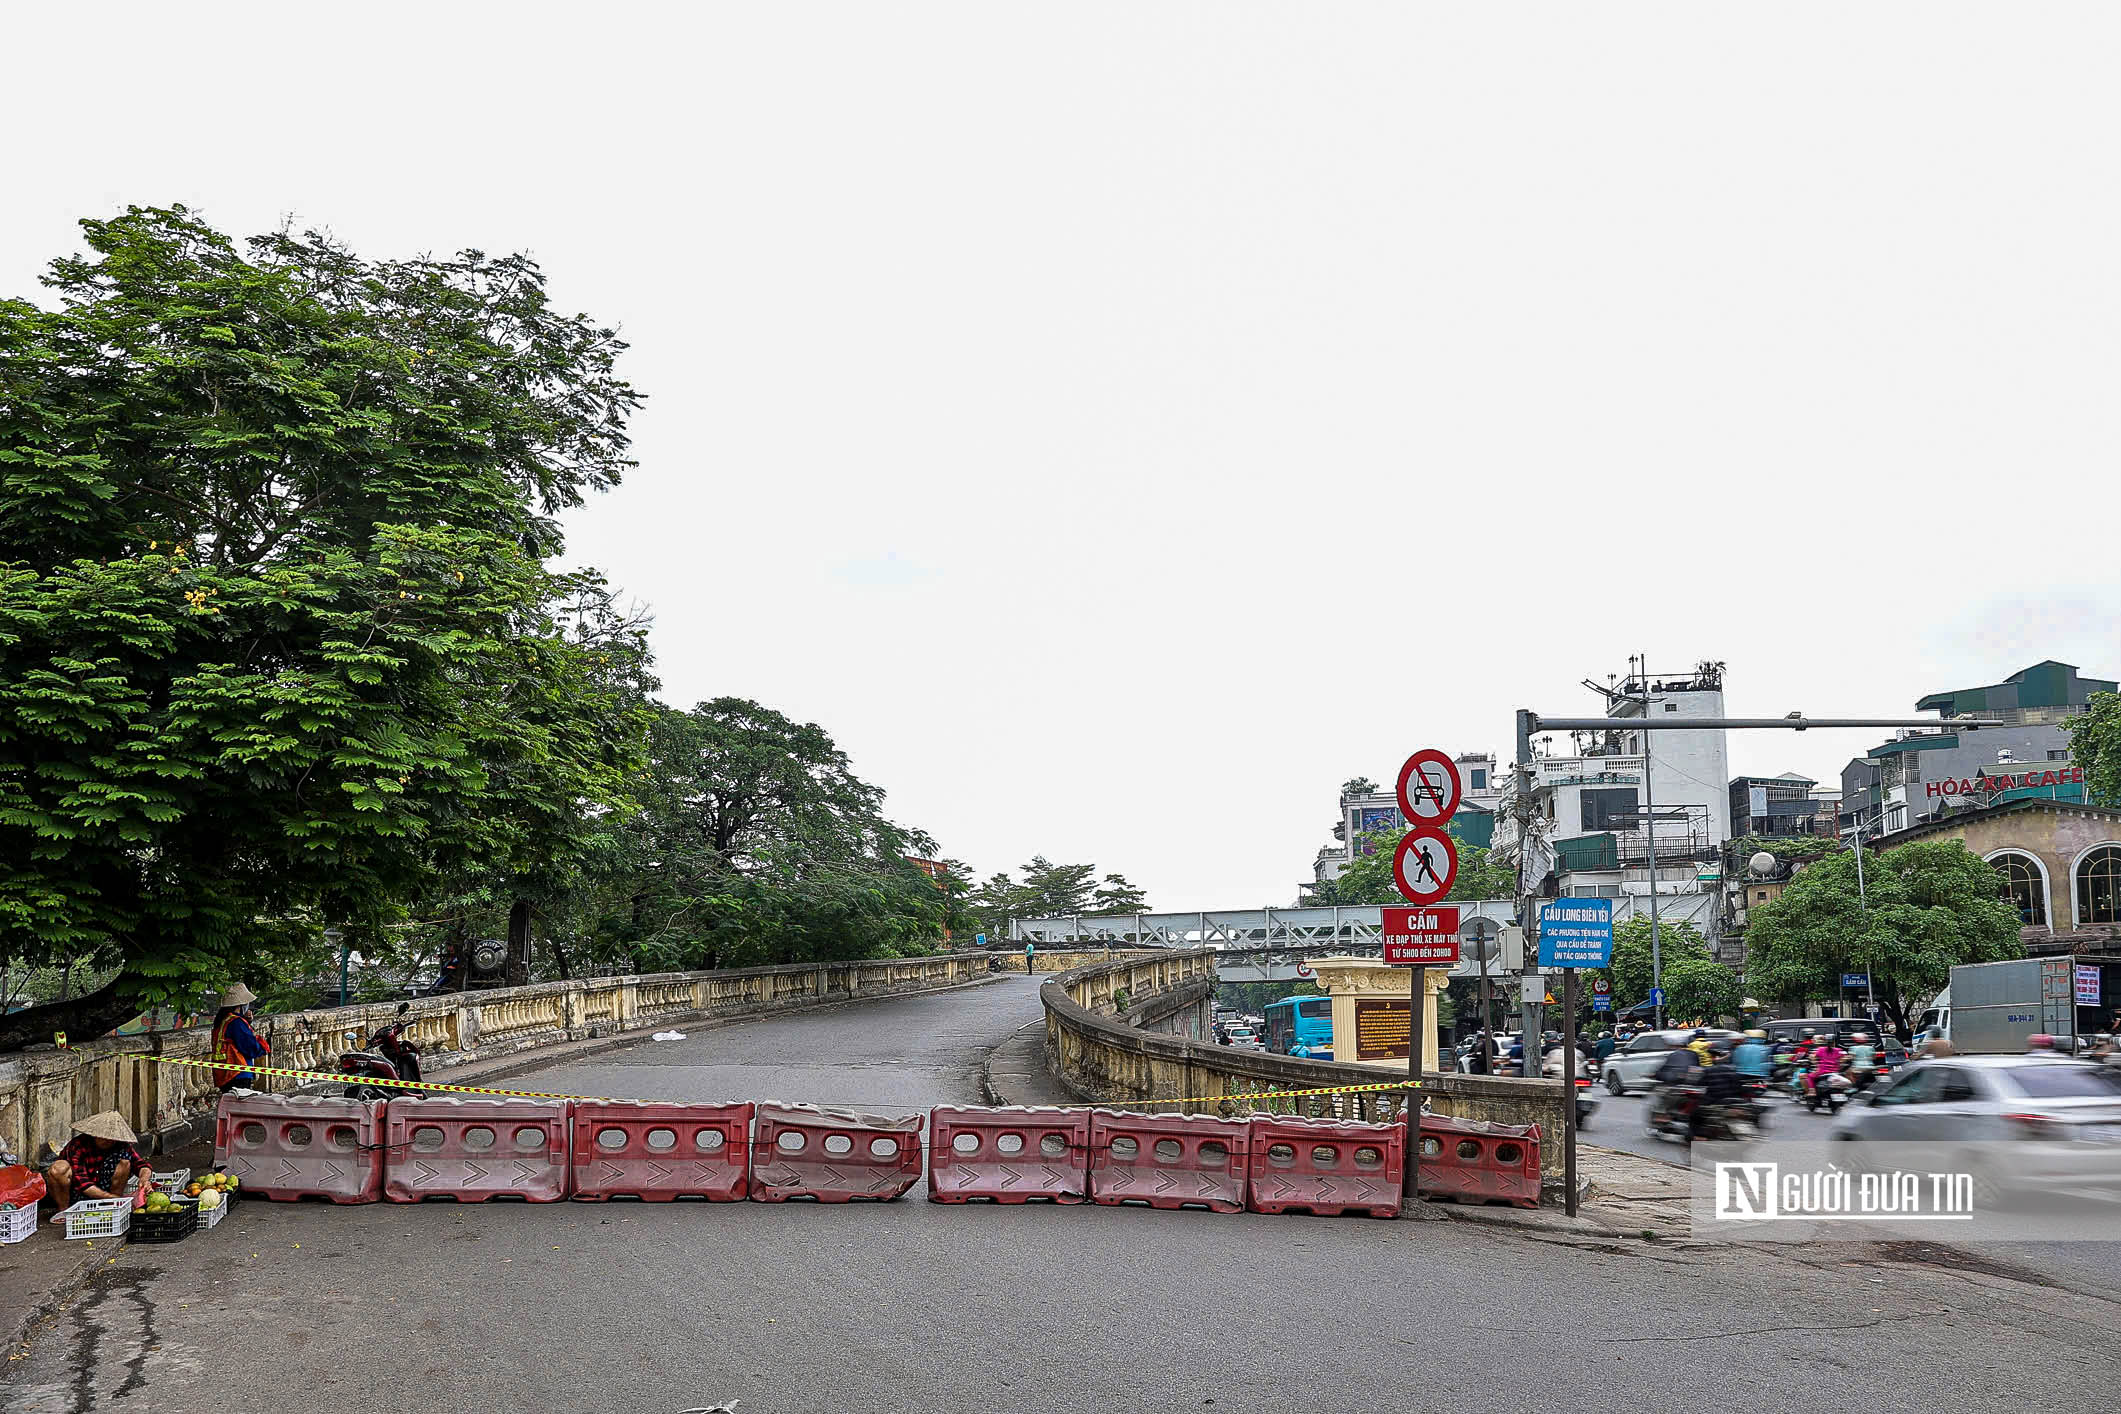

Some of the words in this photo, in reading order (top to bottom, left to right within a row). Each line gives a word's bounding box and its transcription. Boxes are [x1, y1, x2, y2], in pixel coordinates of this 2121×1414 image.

[1926, 776, 1974, 797] HỎA
[1984, 774, 2015, 792] XA
[2024, 768, 2084, 787] CAFE
[1407, 909, 1438, 930] CẤM
[1562, 908, 1581, 921] LONG
[1582, 907, 1596, 922] BIÊN
[1386, 935, 1394, 944] XE
[1396, 935, 1409, 946] ĐẠP
[1424, 934, 1432, 944] XE
[1403, 948, 1418, 957] 5H00
[1433, 948, 1451, 957] 20H00
